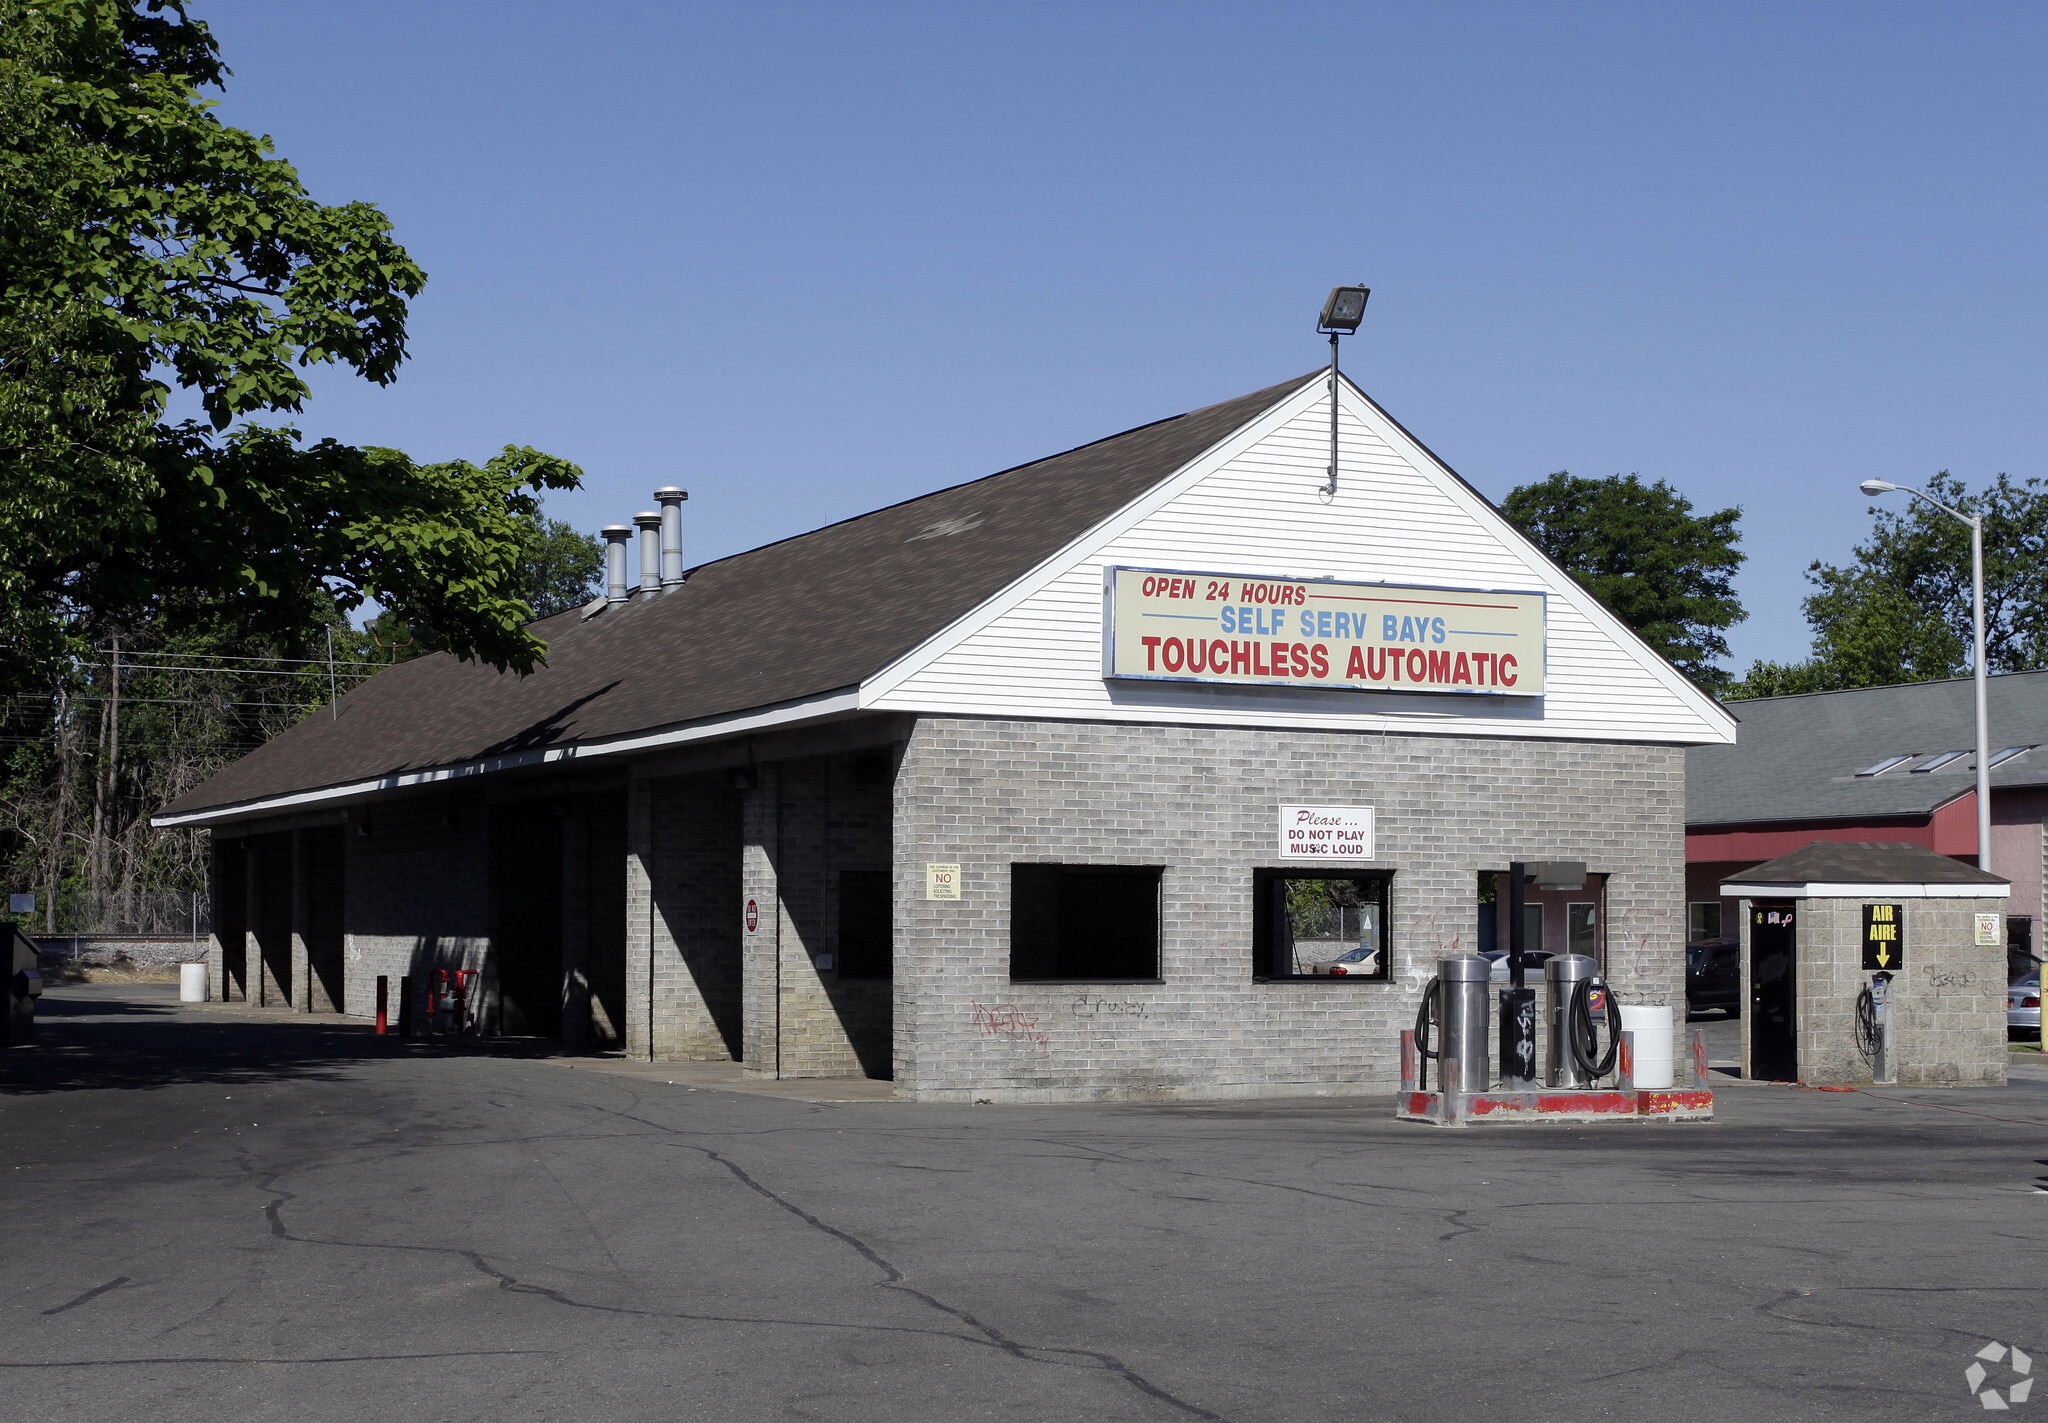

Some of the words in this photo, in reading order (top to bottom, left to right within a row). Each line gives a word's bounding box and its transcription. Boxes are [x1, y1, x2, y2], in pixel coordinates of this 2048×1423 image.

[1142, 576, 1196, 600] OPEN
[1206, 581, 1230, 601] 24
[1240, 583, 1306, 606] HOURS
[1221, 605, 1286, 635] SELF
[1300, 609, 1367, 639] SERV
[1383, 614, 1446, 644] BAYS
[1142, 636, 1329, 678] TOUCHLESS
[1346, 645, 1518, 686] AUTOMATIC
[1288, 829, 1305, 840] DO
[1309, 830, 1333, 841] NOT
[1337, 831, 1365, 841] PLAY
[1290, 844, 1328, 854] MUSC
[1332, 844, 1363, 855] LOUD
[935, 873, 952, 884] NO
[1872, 905, 1893, 921] AIR
[1869, 924, 1897, 941] AIRE
[1981, 922, 1993, 931] NO
